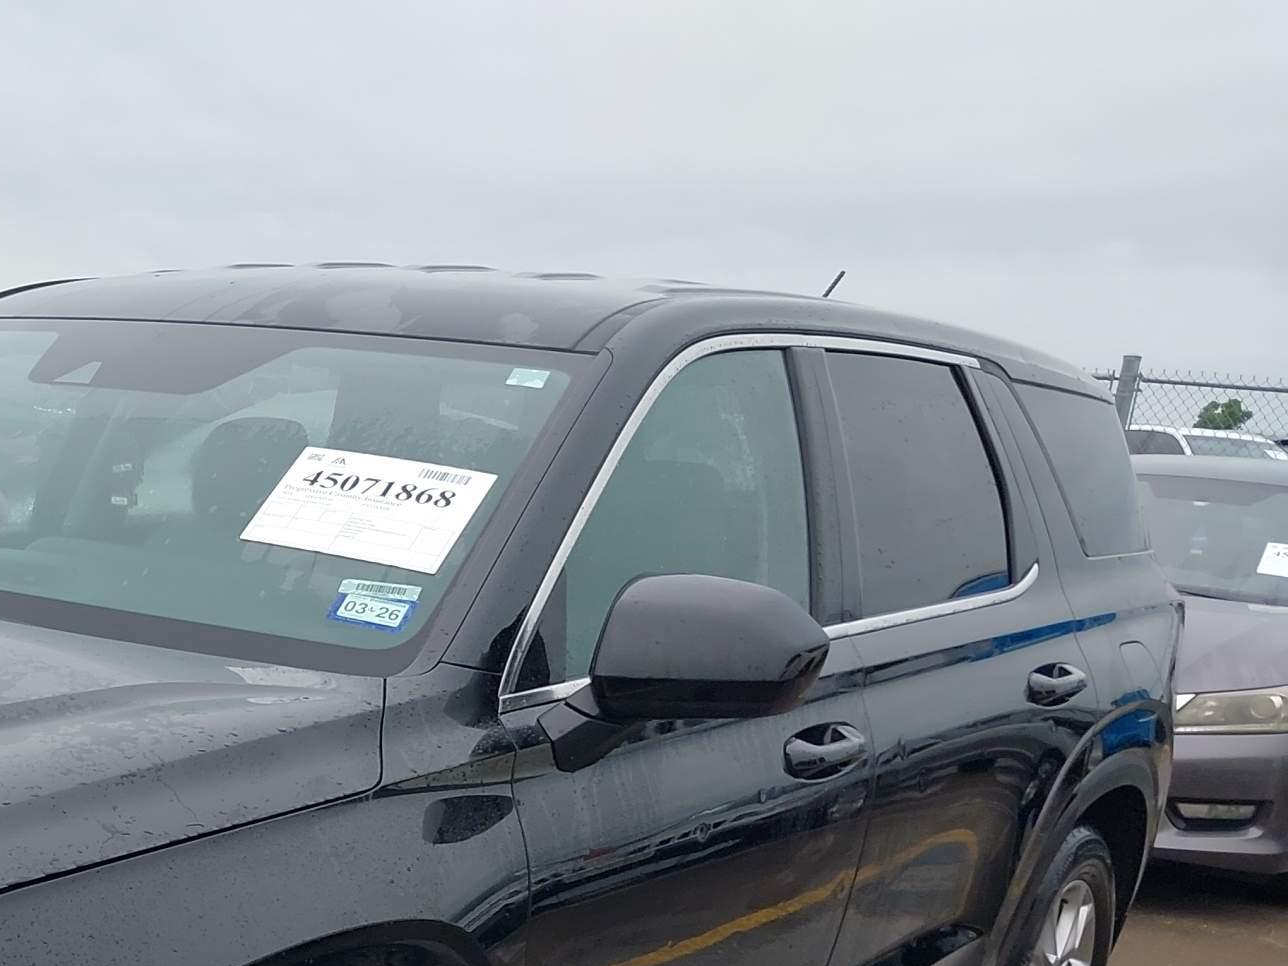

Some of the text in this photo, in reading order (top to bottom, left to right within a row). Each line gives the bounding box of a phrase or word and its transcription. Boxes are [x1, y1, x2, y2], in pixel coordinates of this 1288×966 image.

[303, 470, 456, 508] 45071868
[343, 600, 369, 614] 03
[375, 606, 401, 621] 26
